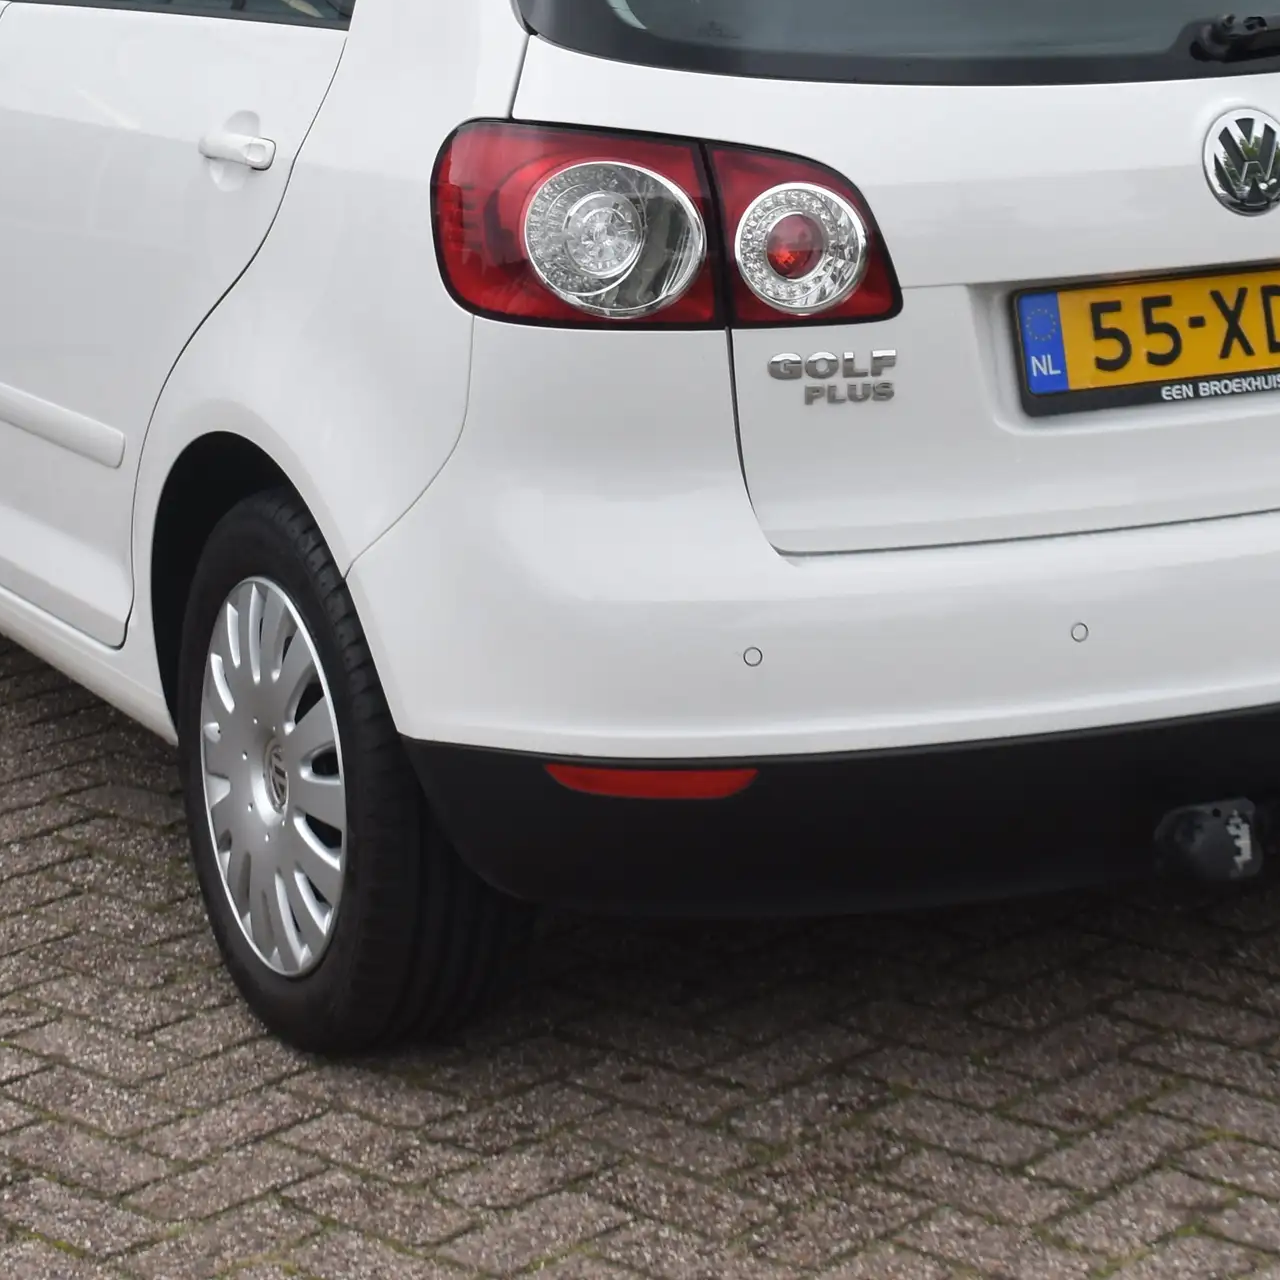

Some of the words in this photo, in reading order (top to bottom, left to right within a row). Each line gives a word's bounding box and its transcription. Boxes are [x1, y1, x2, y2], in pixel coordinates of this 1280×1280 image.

[767, 349, 897, 380] GOLF
[1030, 355, 1061, 377] NL
[804, 382, 895, 405] PLUS
[1161, 384, 1194, 401] EEN
